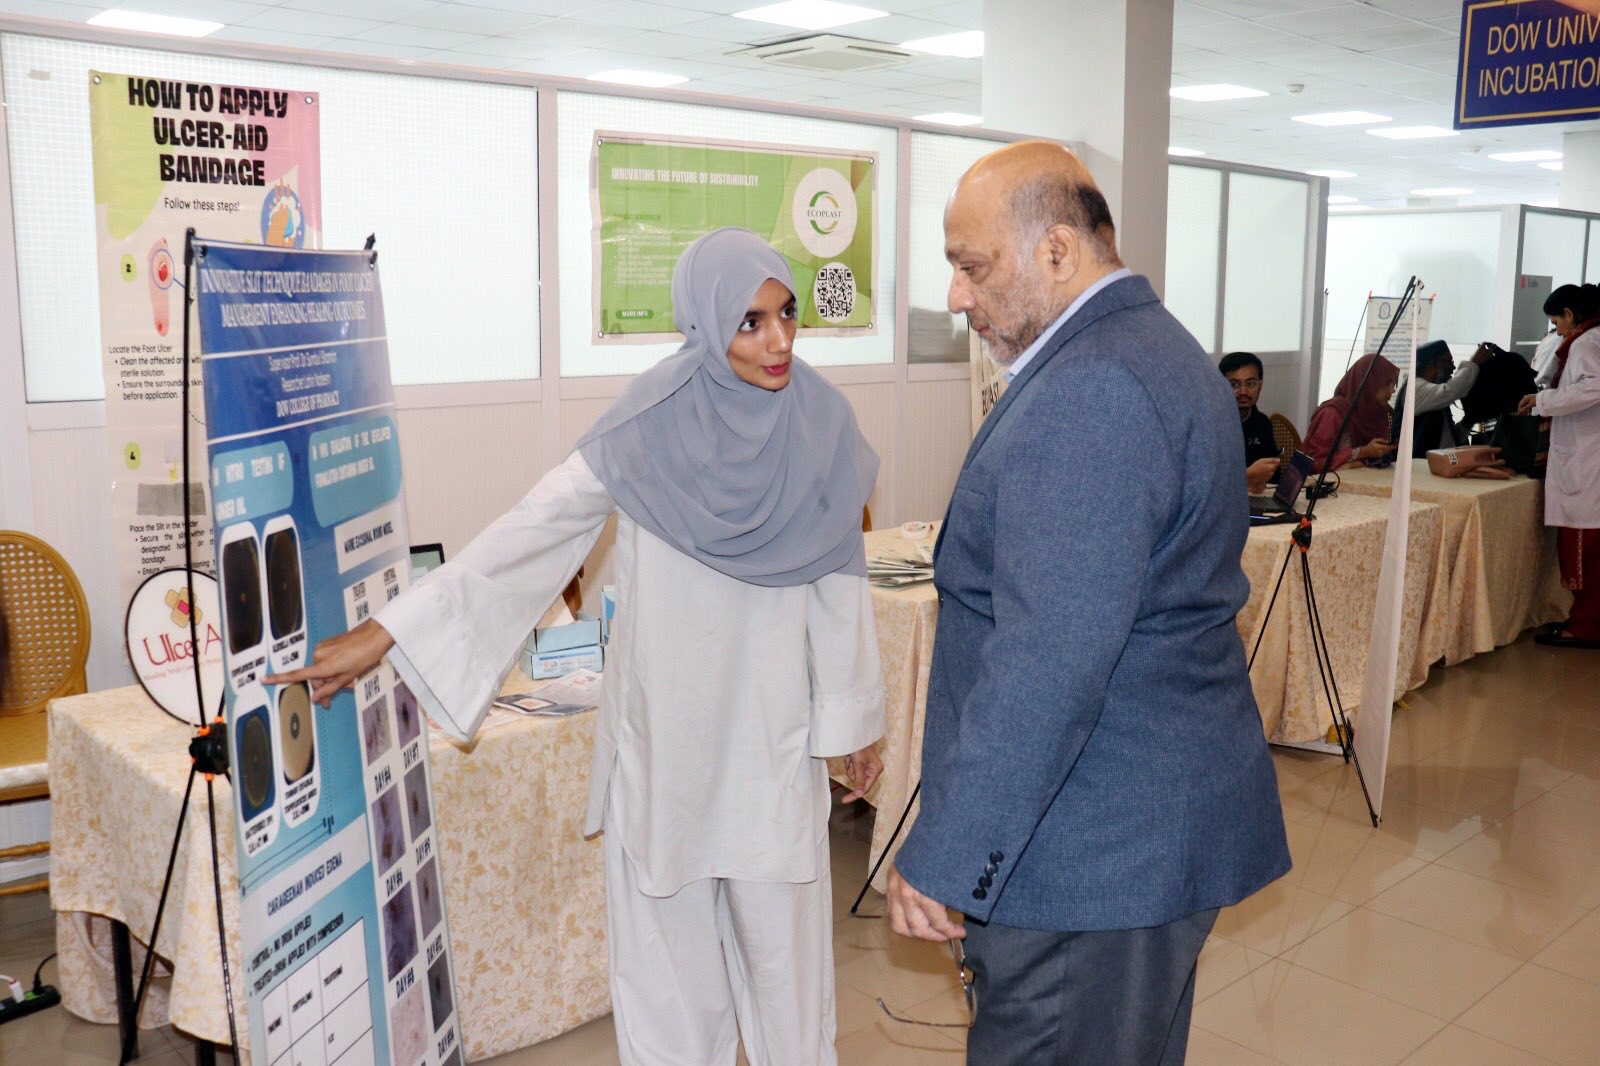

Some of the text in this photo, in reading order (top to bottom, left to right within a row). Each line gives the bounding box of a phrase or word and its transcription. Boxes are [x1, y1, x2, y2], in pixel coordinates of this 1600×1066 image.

[1488, 20, 1541, 55] DOW
[1479, 57, 1600, 97] INCUBATIO
[128, 77, 288, 118] HOW TO APPLY
[153, 116, 268, 151] ULCER-AID
[159, 153, 266, 186] BANDAGE
[612, 167, 655, 181] INNOVATING
[657, 169, 670, 183] THE
[671, 170, 698, 184] FUTURE
[699, 171, 708, 184] OF
[164, 197, 240, 213] Follow these steps!
[807, 210, 841, 218] ECOPLAST
[126, 264, 132, 272] 2
[109, 344, 173, 354] Locate the Foot Ulcer
[120, 356, 137, 365] Clean
[139, 356, 149, 365] the
[149, 355, 174, 365] affected
[120, 369, 139, 377] sterile
[122, 380, 143, 388] Ensure
[144, 380, 154, 388] the
[123, 392, 143, 400] before
[130, 525, 144, 533] Place
[140, 535, 158, 543] Secure
[141, 544, 171, 554] designated
[375, 764, 391, 794] DAY#4
[305, 863, 325, 892] INDUCED
[326, 851, 343, 875] EDEMA
